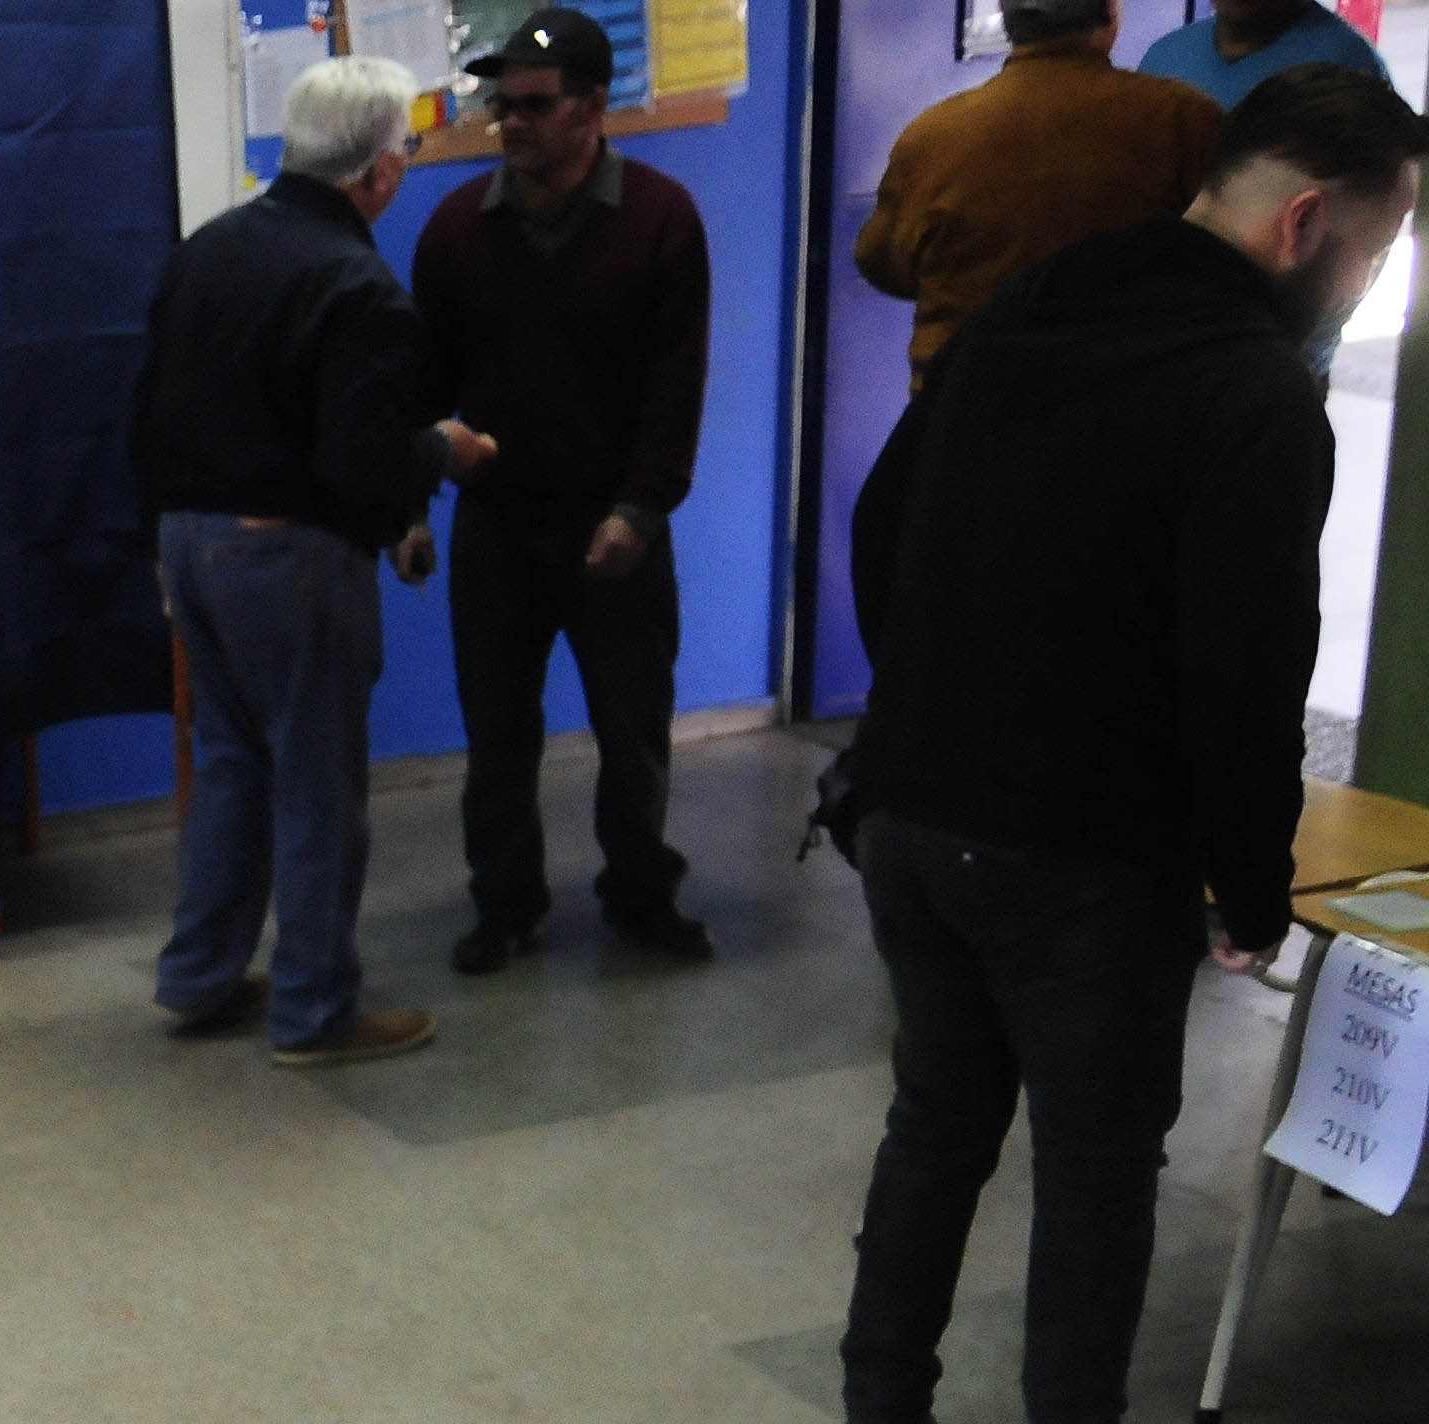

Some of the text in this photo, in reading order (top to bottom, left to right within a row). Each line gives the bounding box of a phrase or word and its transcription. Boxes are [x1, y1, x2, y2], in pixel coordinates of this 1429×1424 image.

[1345, 962, 1421, 1016] MESAS
[1342, 1013, 1399, 1060] 209V
[1332, 1066, 1390, 1110] 210V
[1316, 1118, 1379, 1164] 211V
